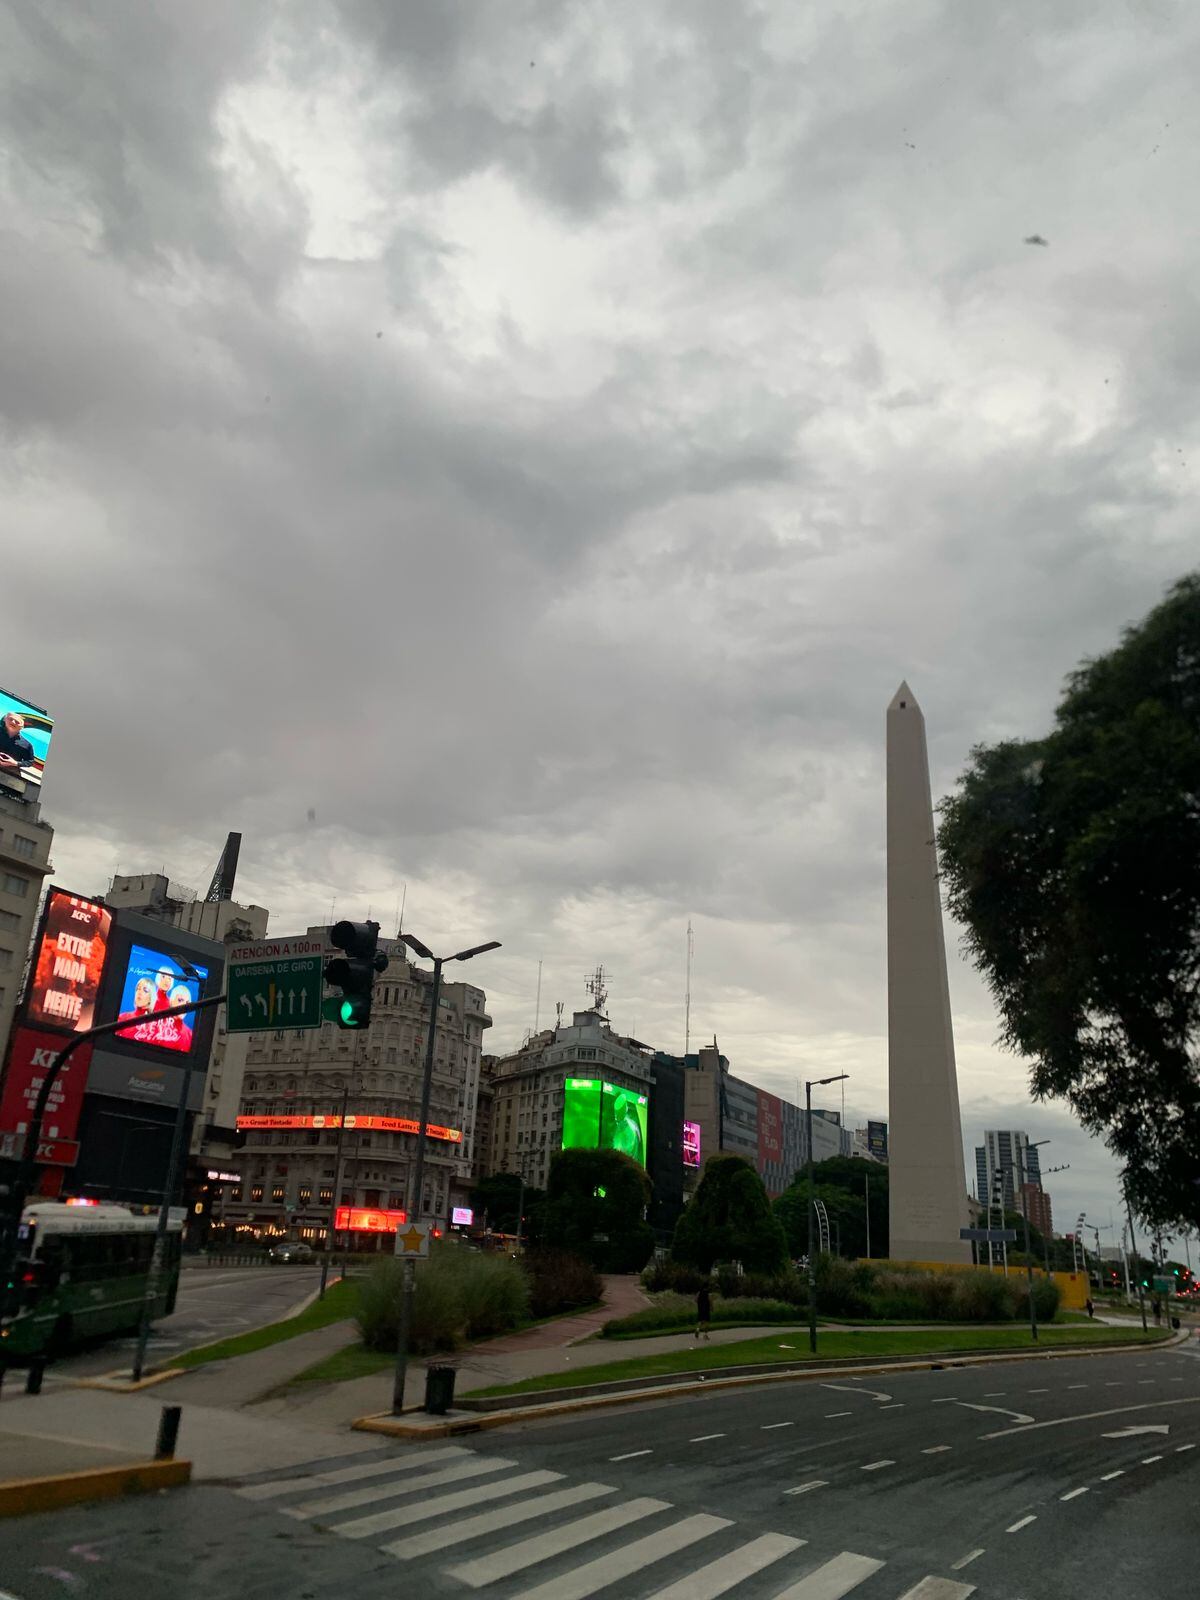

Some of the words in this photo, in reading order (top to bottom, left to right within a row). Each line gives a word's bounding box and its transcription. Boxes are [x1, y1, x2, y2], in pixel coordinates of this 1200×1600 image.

[70, 909, 92, 923] KFC
[57, 931, 94, 959] EXTRE
[230, 944, 280, 960] ATENCION
[283, 943, 290, 954] A
[235, 963, 275, 977] DARSENA
[277, 962, 289, 974] DE
[290, 960, 314, 973] GIRO
